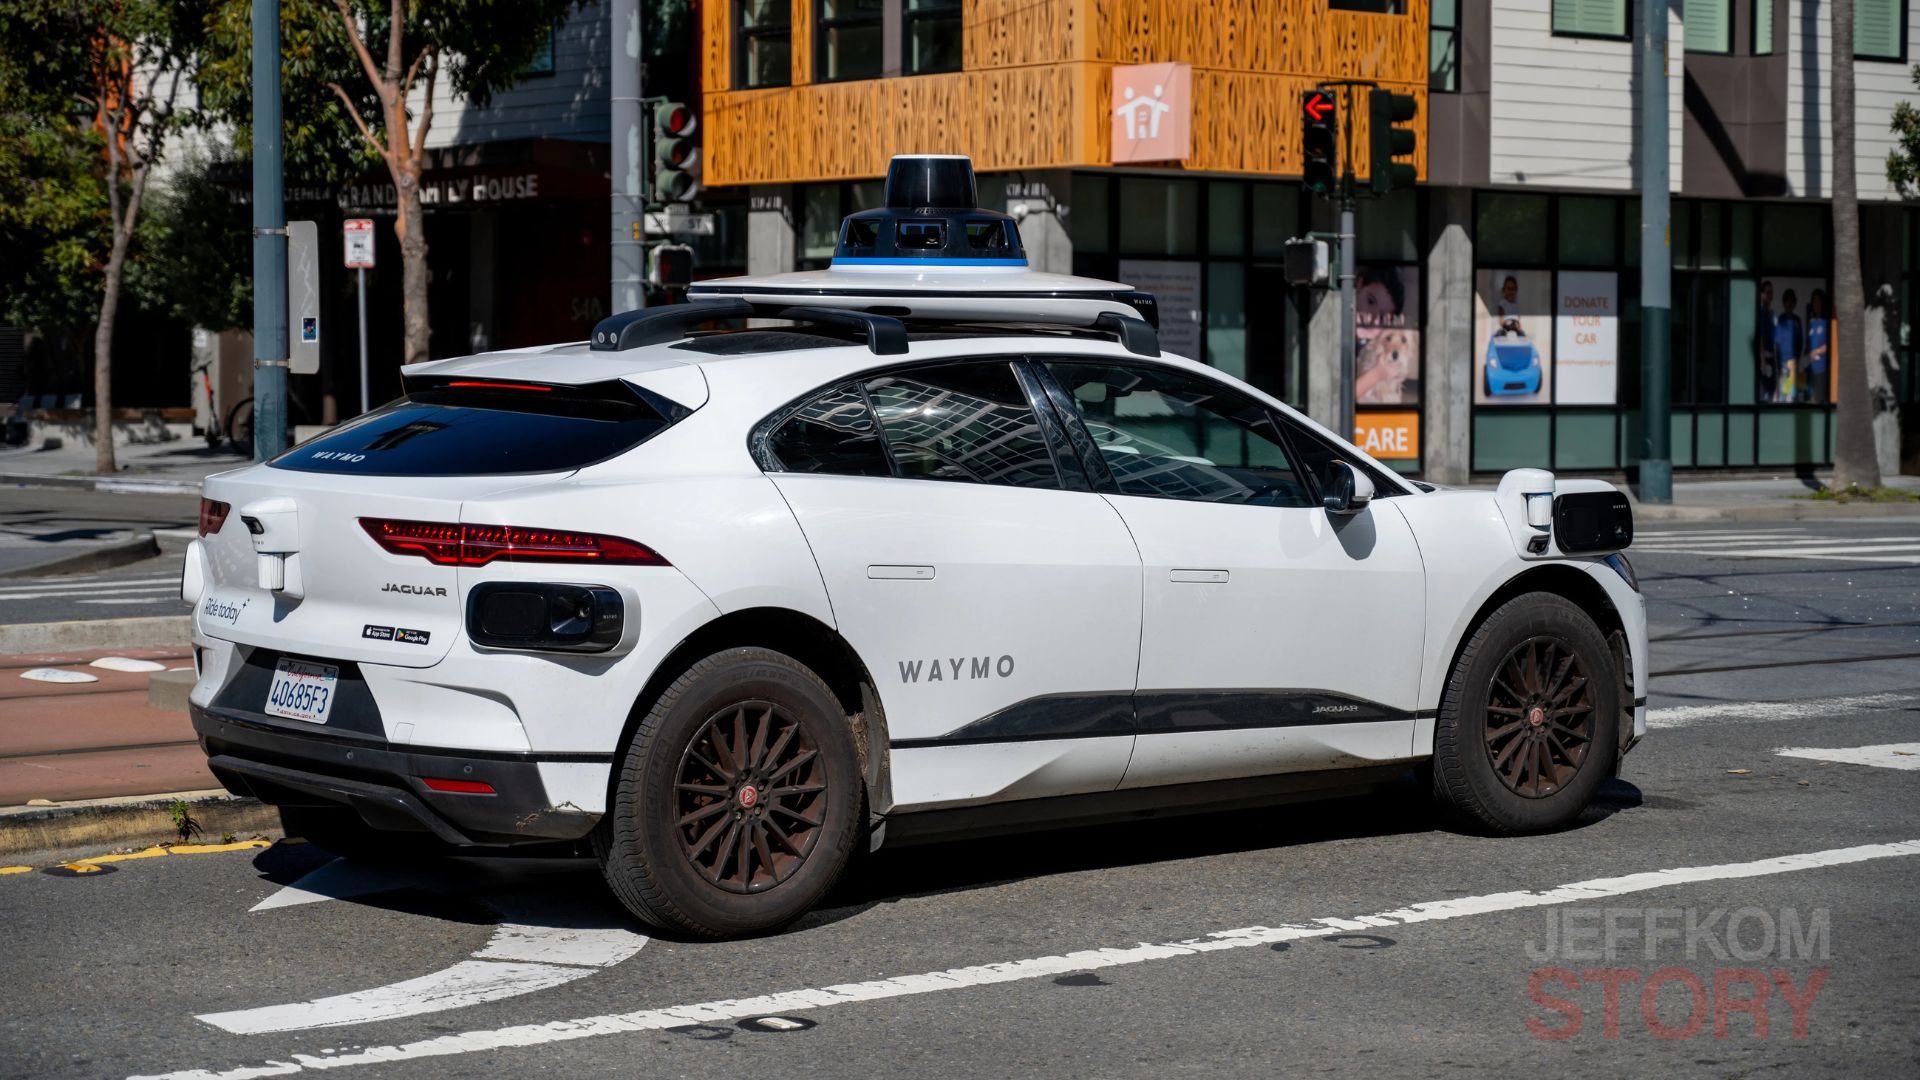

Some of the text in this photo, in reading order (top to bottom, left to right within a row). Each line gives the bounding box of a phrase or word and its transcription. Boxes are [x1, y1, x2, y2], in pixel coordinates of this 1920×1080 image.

[337, 184, 397, 208] GRAND
[473, 174, 539, 201] HOUSE
[1563, 295, 1609, 309] DONATE
[1572, 313, 1601, 327] YOUR
[1575, 332, 1597, 345] CAR
[311, 451, 366, 462] WAYMO
[381, 583, 447, 597] JAGUAR
[203, 597, 241, 626] Ride today
[404, 633, 428, 644] Google Play
[898, 654, 1015, 684] WAYMO
[271, 679, 329, 714] 40685F3
[1312, 705, 1359, 713] JAGUAR
